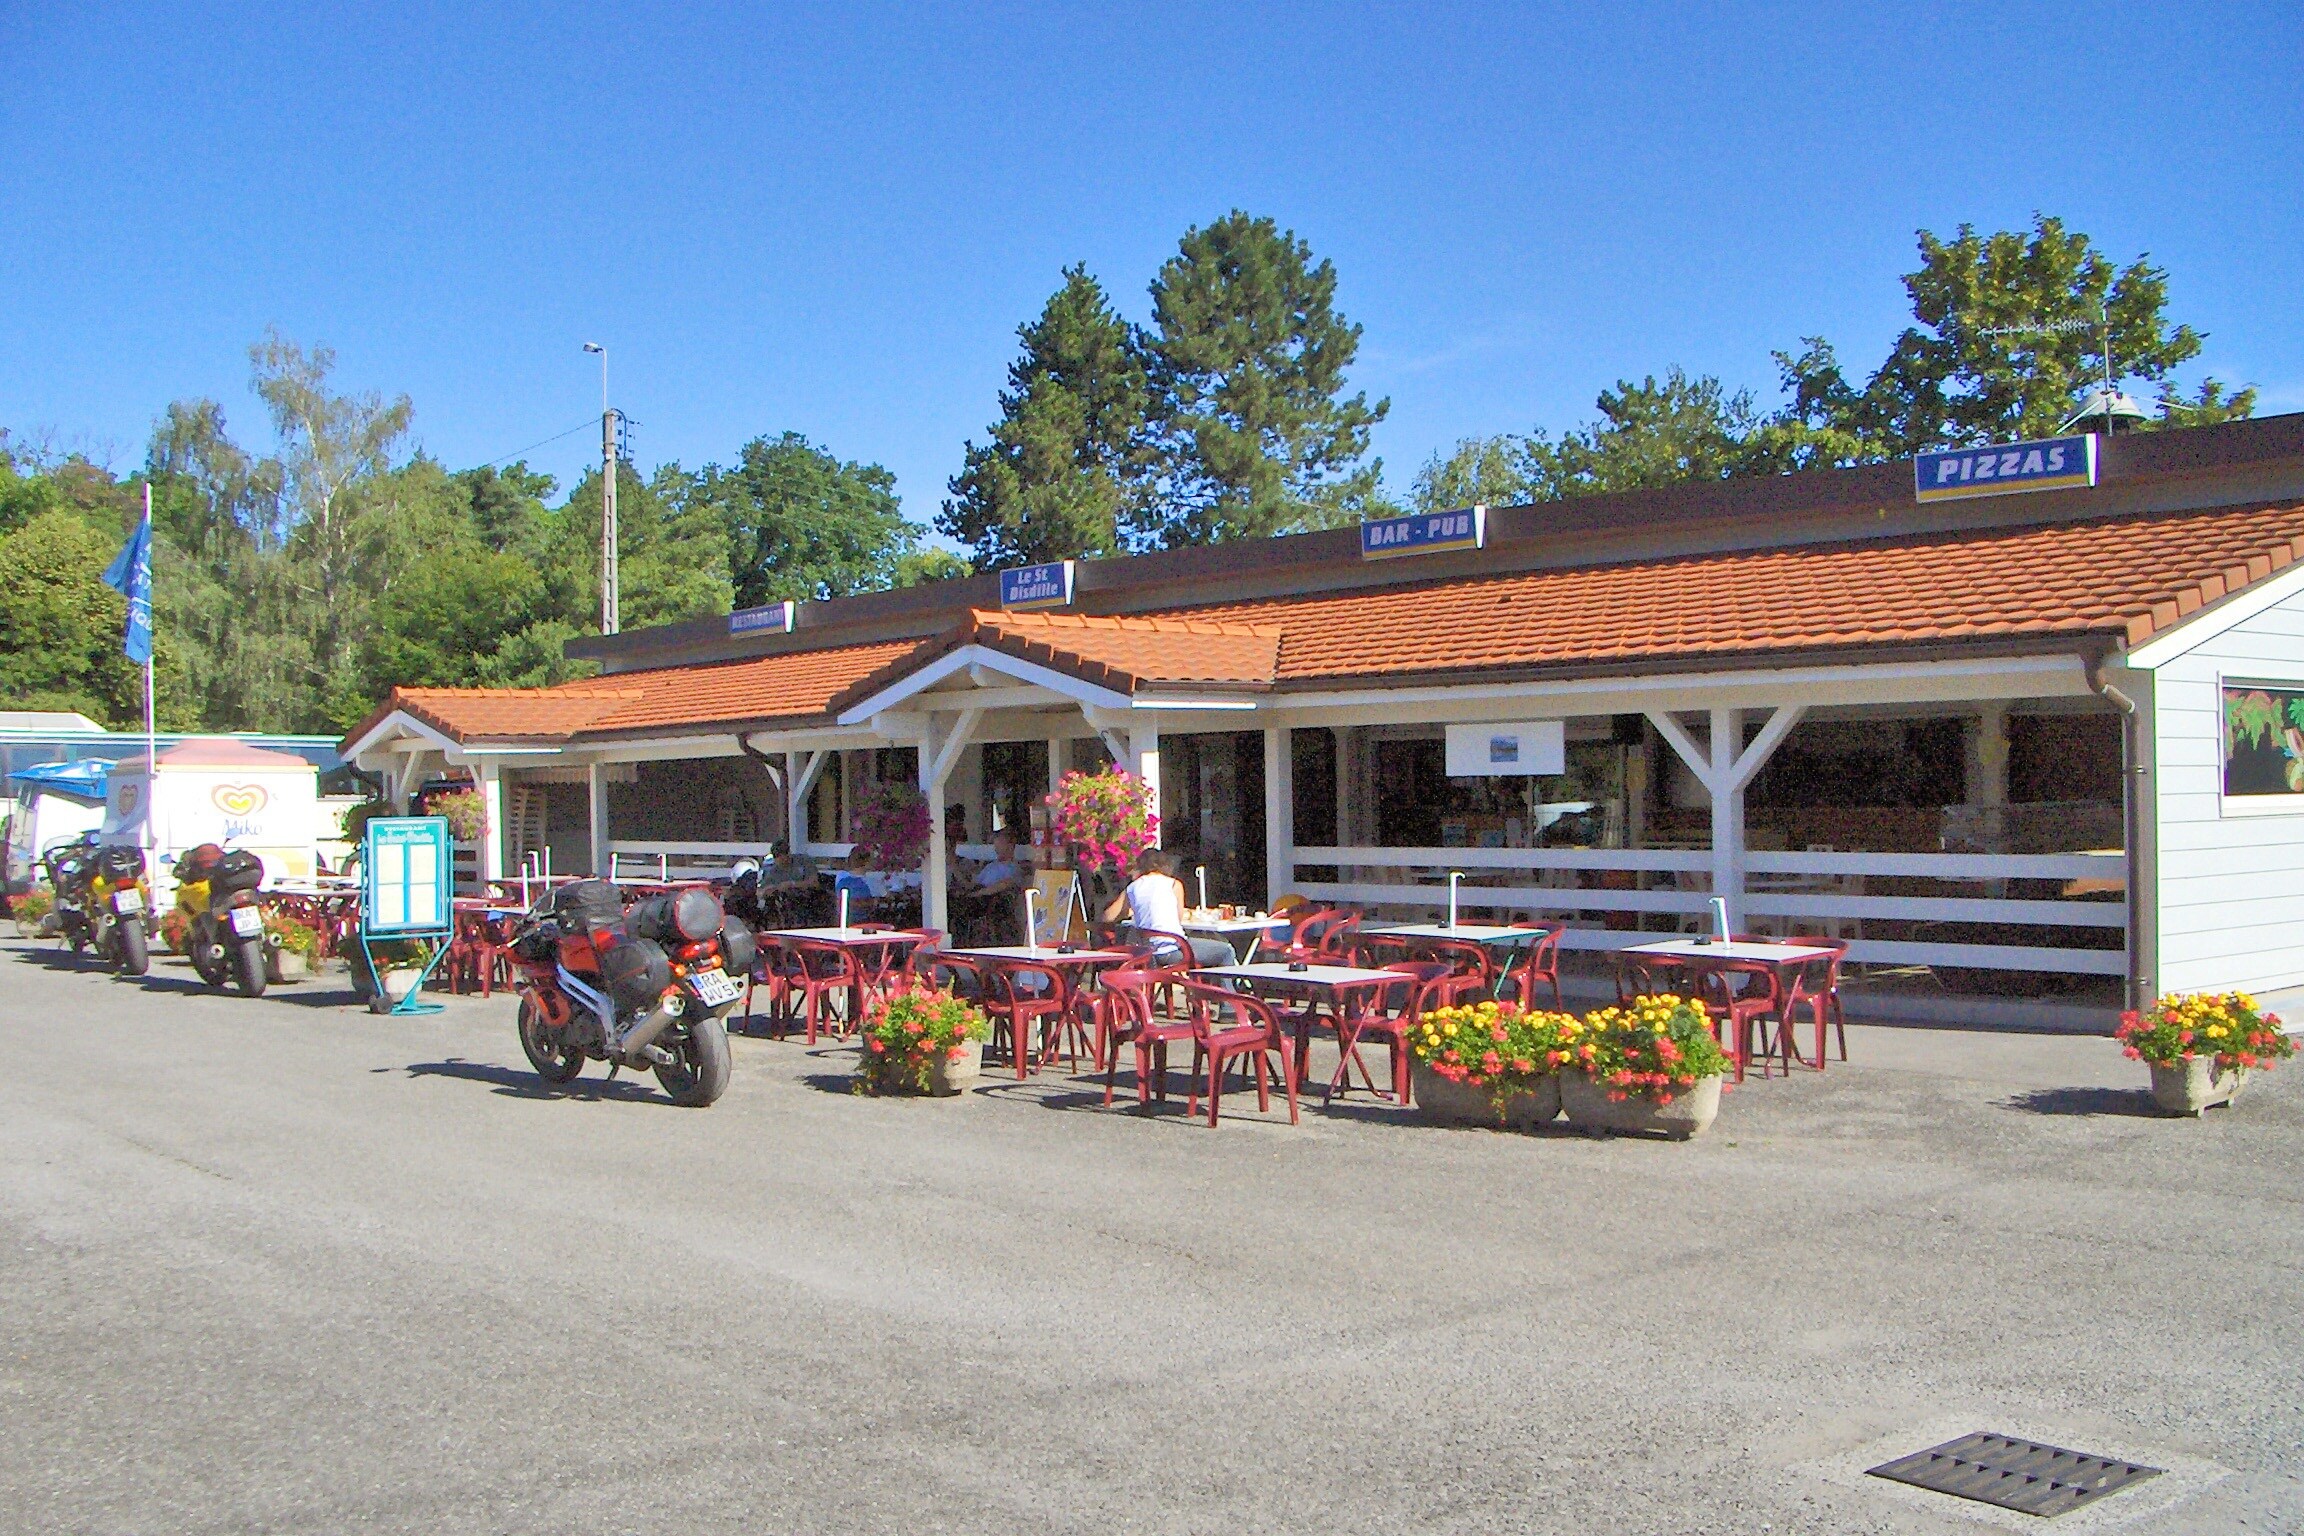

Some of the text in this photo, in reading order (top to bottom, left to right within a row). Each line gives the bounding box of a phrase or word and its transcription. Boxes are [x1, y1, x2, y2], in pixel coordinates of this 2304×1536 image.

[1936, 446, 2065, 483] PIZZAS
[1370, 522, 1410, 546] BAR
[1428, 515, 1469, 539] PUB
[1018, 568, 1048, 584] Le St
[701, 973, 722, 988] RA
